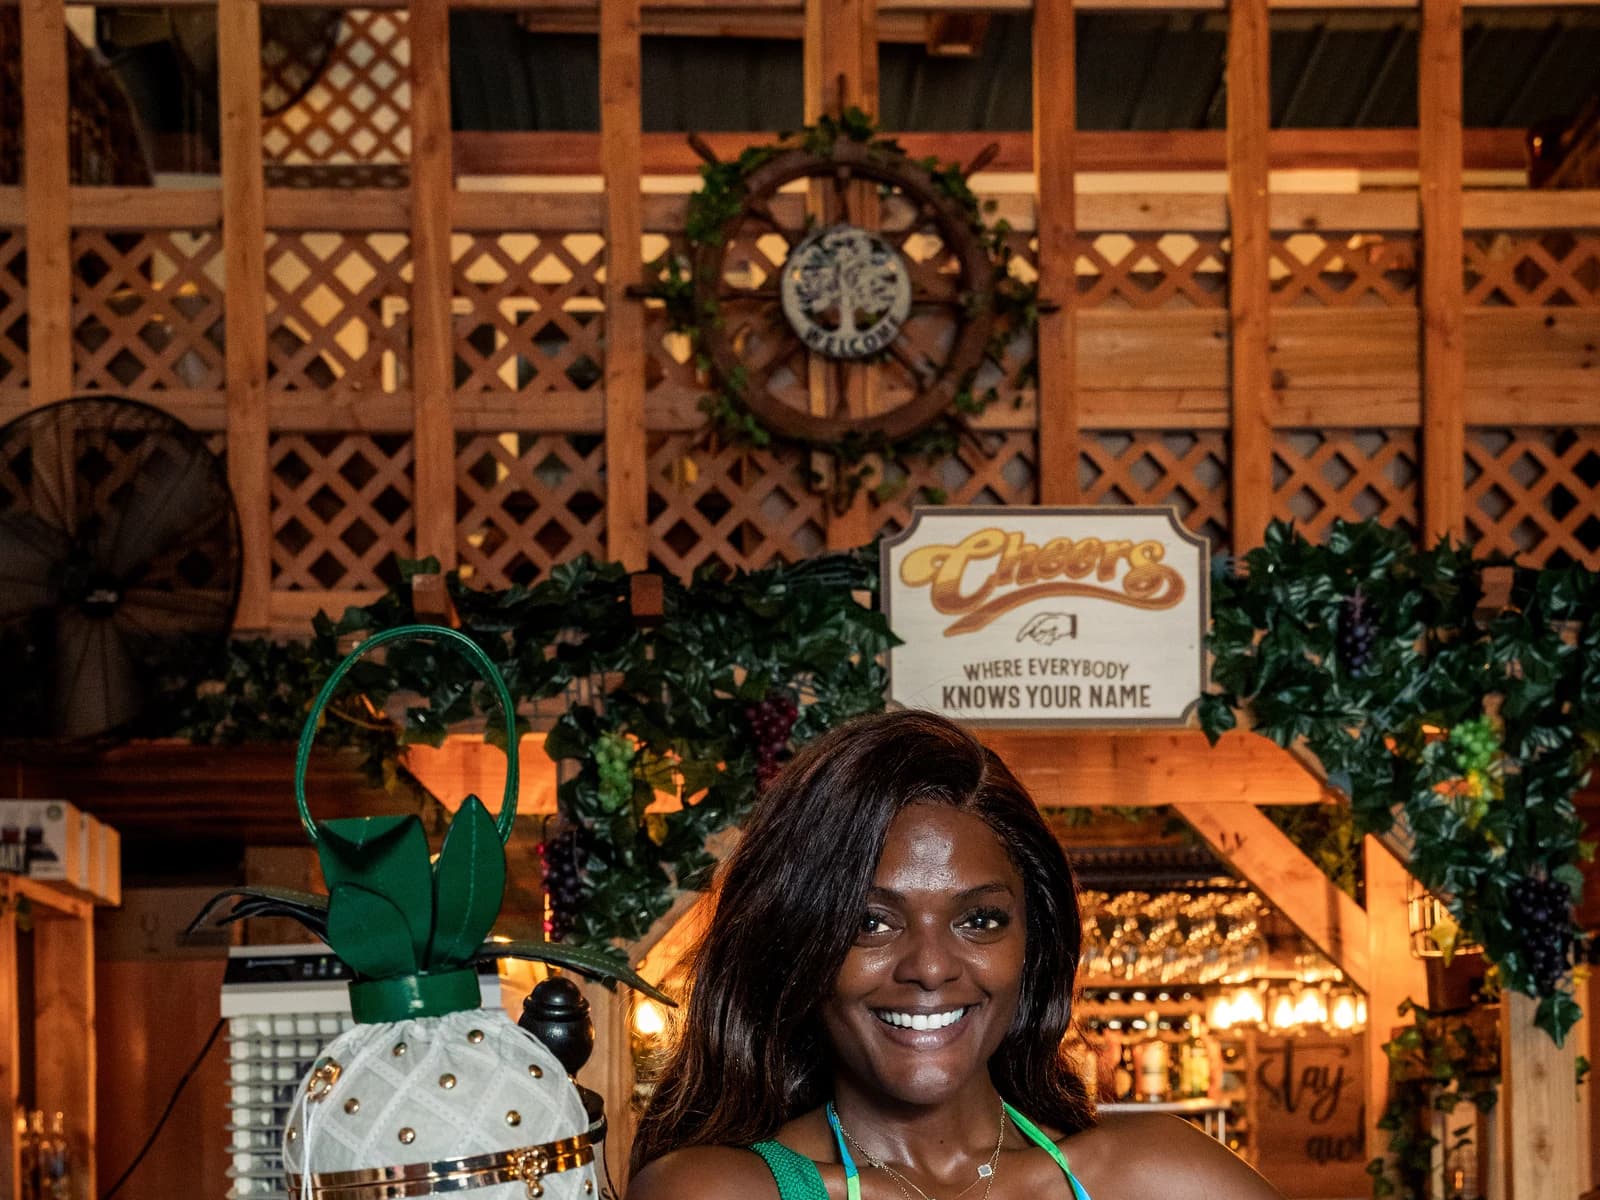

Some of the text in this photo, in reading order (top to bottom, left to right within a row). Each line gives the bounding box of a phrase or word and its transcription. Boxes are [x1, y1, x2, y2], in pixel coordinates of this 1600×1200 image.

[805, 313, 899, 353] WELCOME
[900, 528, 1185, 637] Cheers
[963, 658, 1129, 681] WHERE EVERYBODY
[942, 684, 1151, 709] KNOWS YOUR NAME
